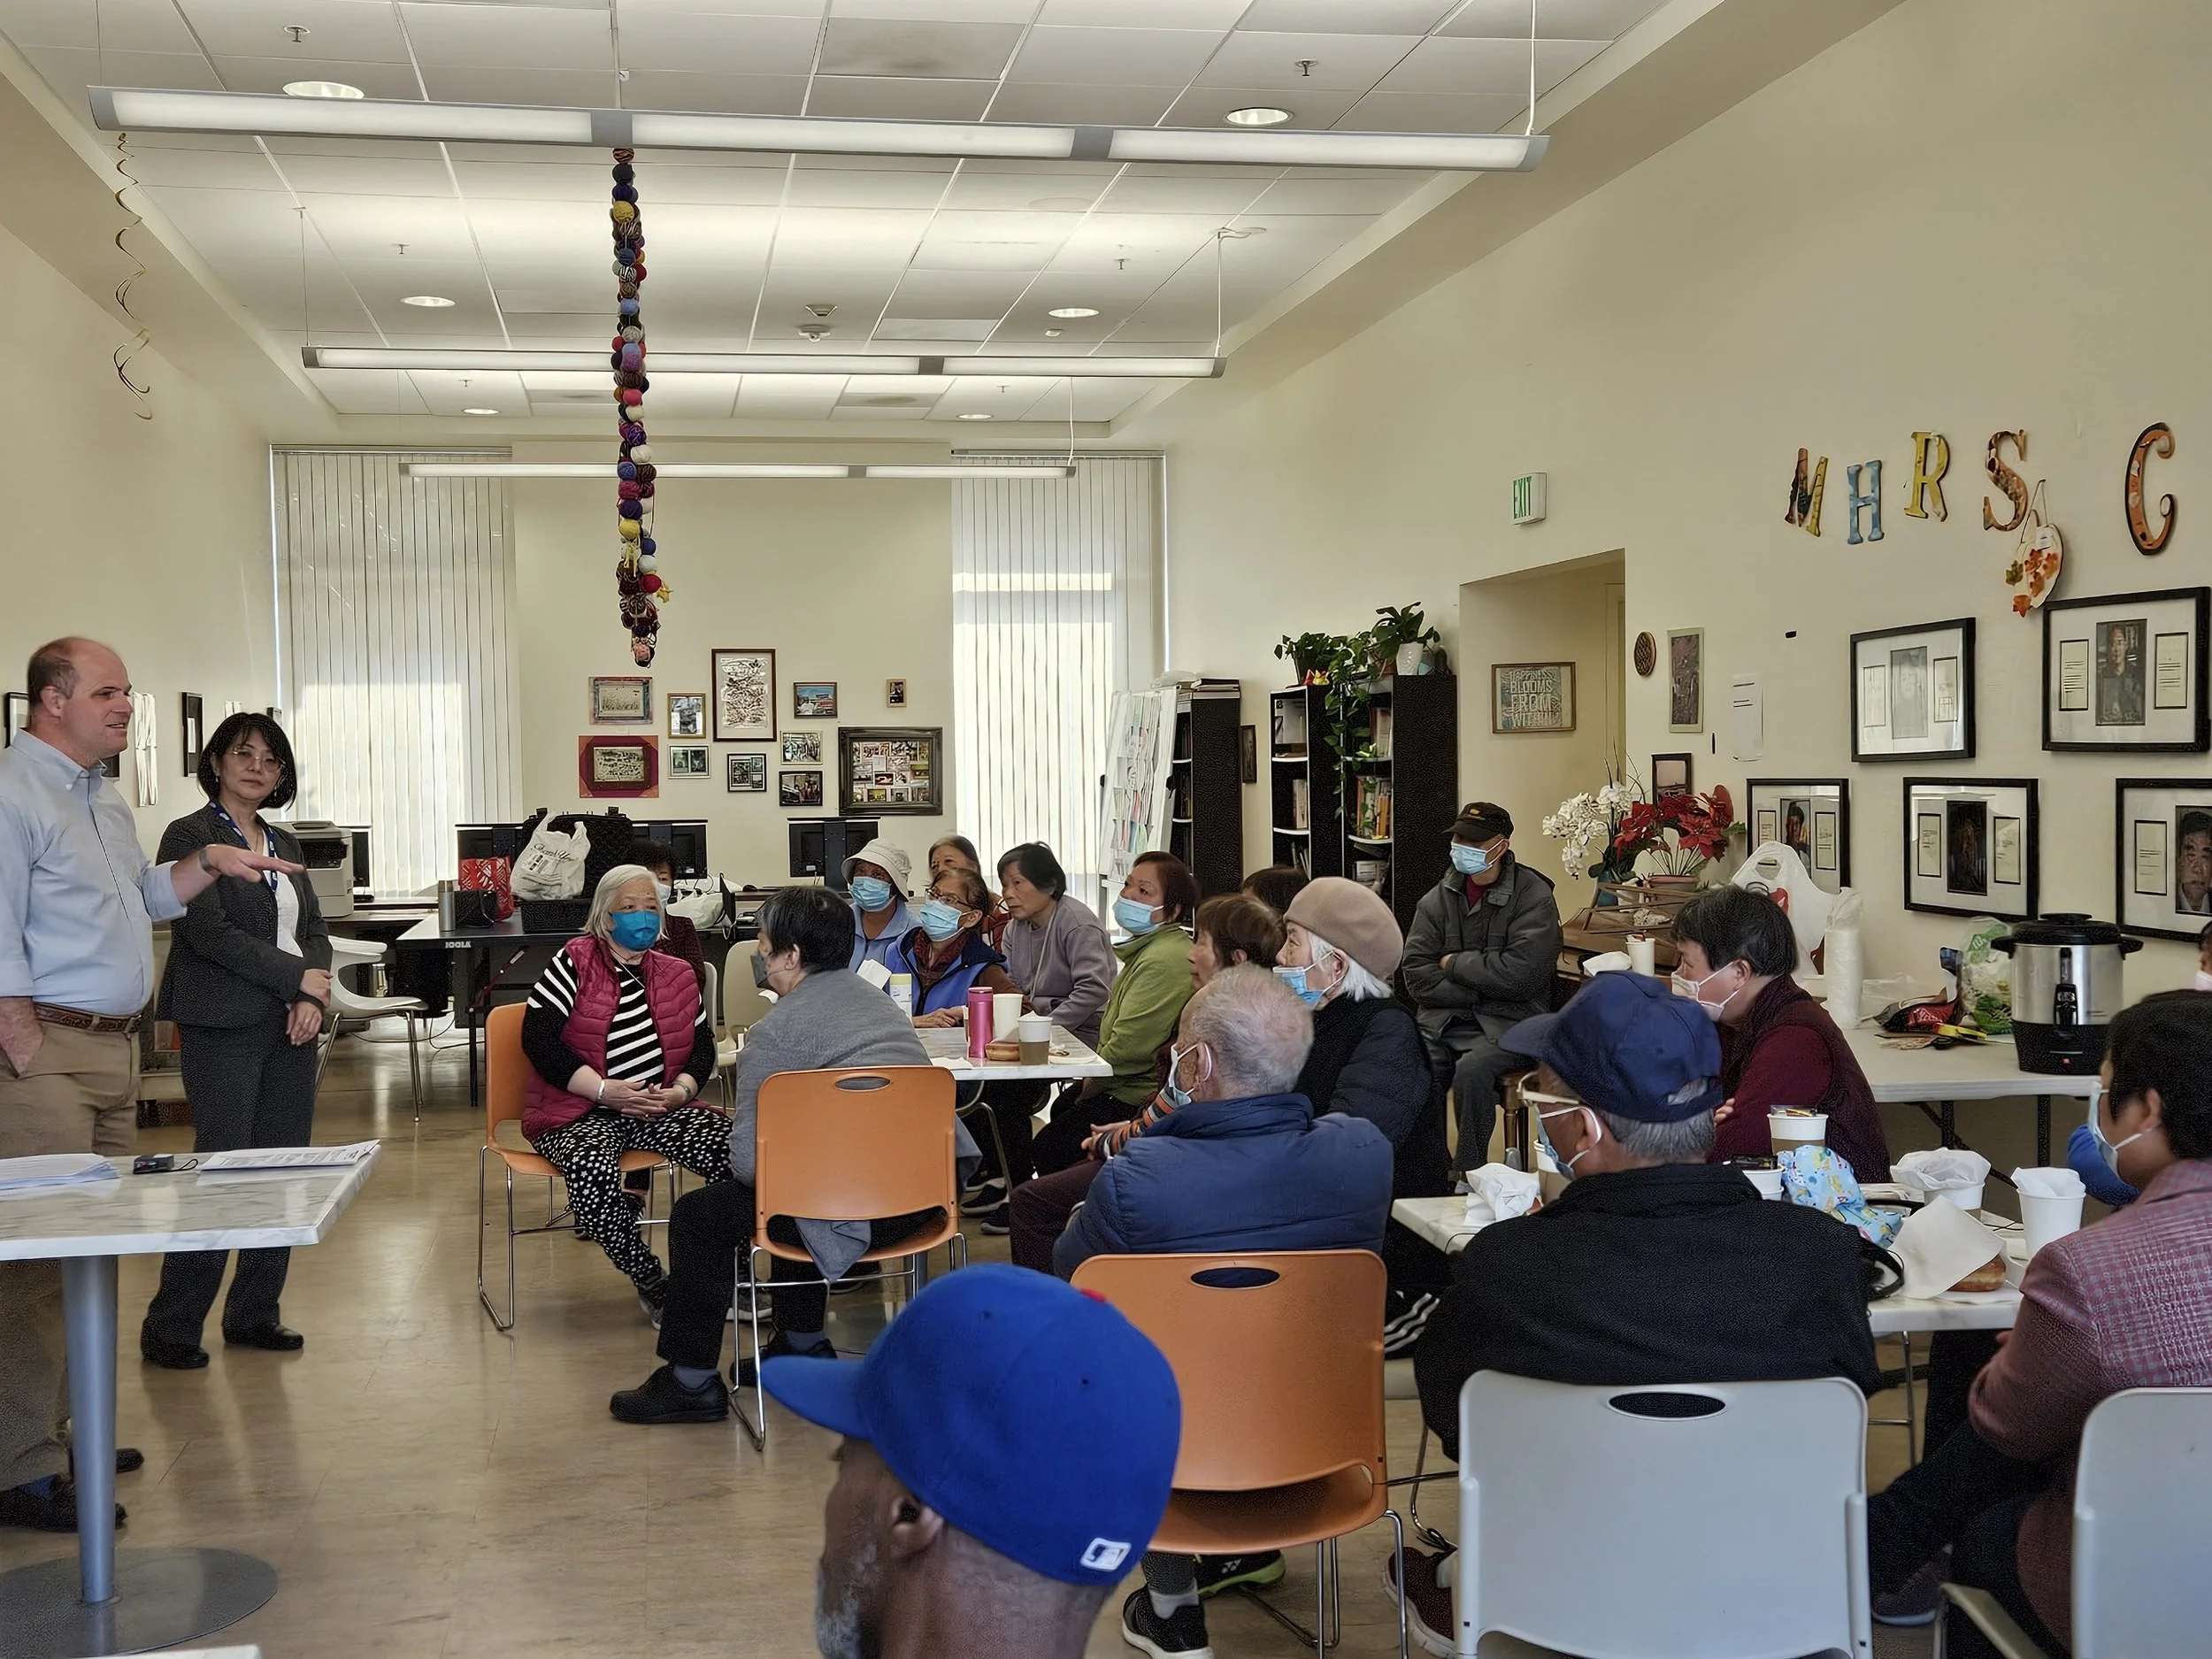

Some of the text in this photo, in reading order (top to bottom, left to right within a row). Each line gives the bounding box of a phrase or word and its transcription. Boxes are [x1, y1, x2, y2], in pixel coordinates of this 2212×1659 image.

[1513, 476, 1532, 519] EXIT
[1510, 680, 1553, 694] BLOOMS
[1511, 694, 1552, 711] FROM
